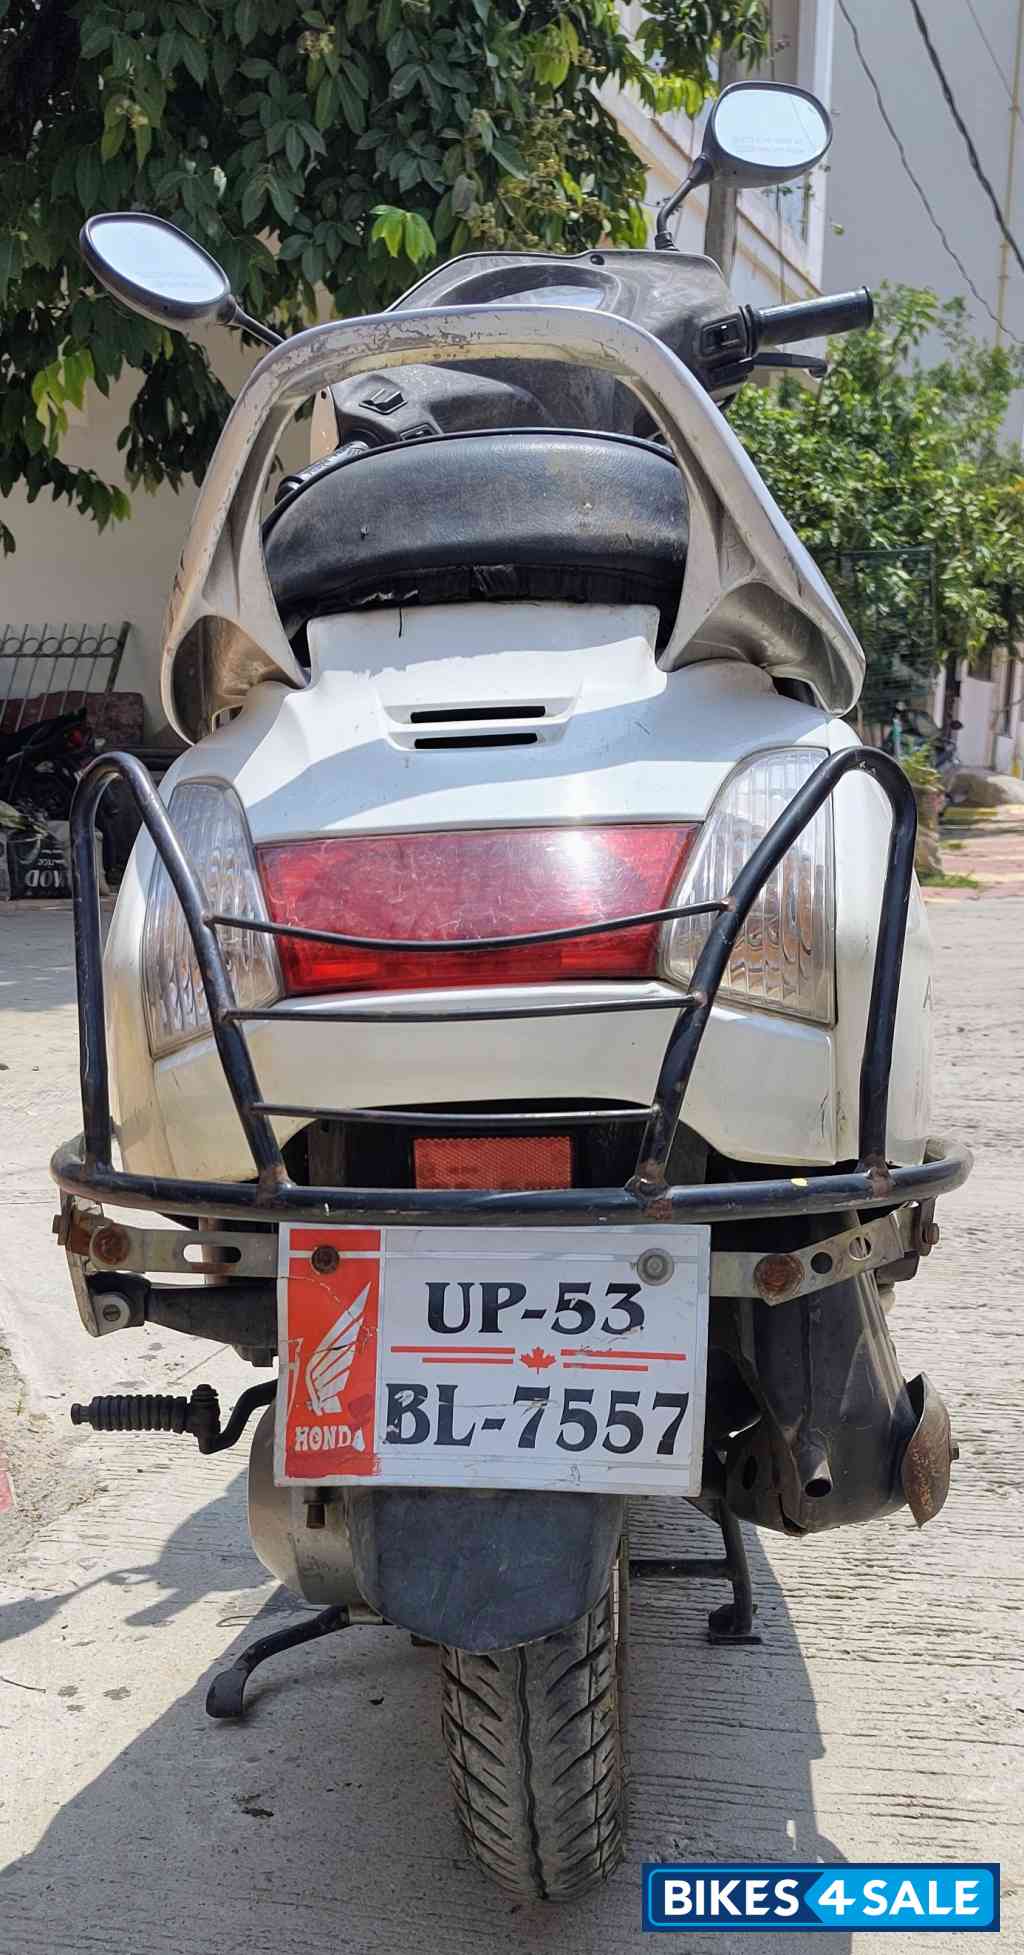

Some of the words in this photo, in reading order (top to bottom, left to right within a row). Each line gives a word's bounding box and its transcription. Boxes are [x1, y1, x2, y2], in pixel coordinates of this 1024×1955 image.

[425, 1282, 646, 1335] UP-53
[294, 1426, 366, 1452] HONDA
[384, 1383, 690, 1455] BL-7557
